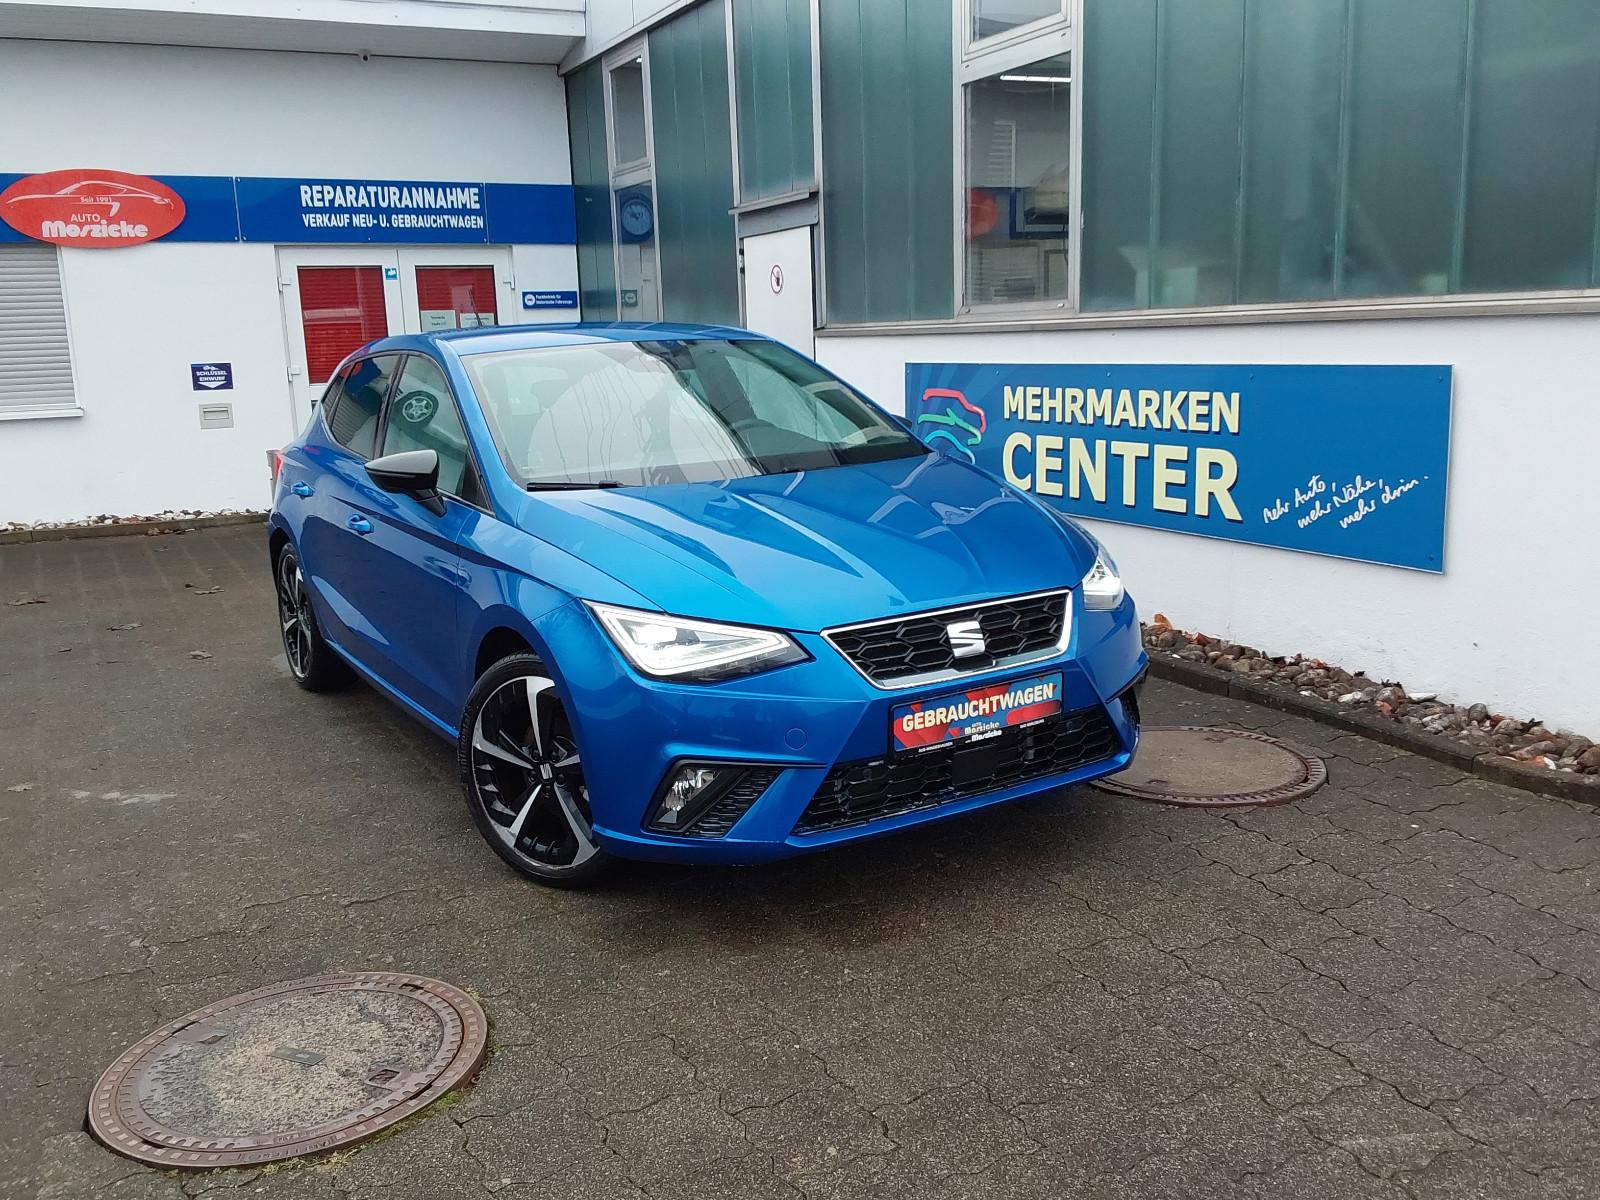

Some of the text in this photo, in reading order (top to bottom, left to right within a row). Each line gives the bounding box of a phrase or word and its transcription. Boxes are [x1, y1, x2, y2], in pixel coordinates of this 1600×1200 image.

[299, 184, 481, 210] REPARATURANNAHME
[41, 220, 149, 238] Moszicke
[70, 213, 100, 223] AUTO
[302, 213, 484, 229] VERKAUF NEU- U. GEBRAUCHTWAGEN
[1002, 384, 1241, 434] MEHRMARKEN
[1001, 430, 1245, 523] CENTER
[902, 682, 1054, 732] GEBRAUCHTWAGEN
